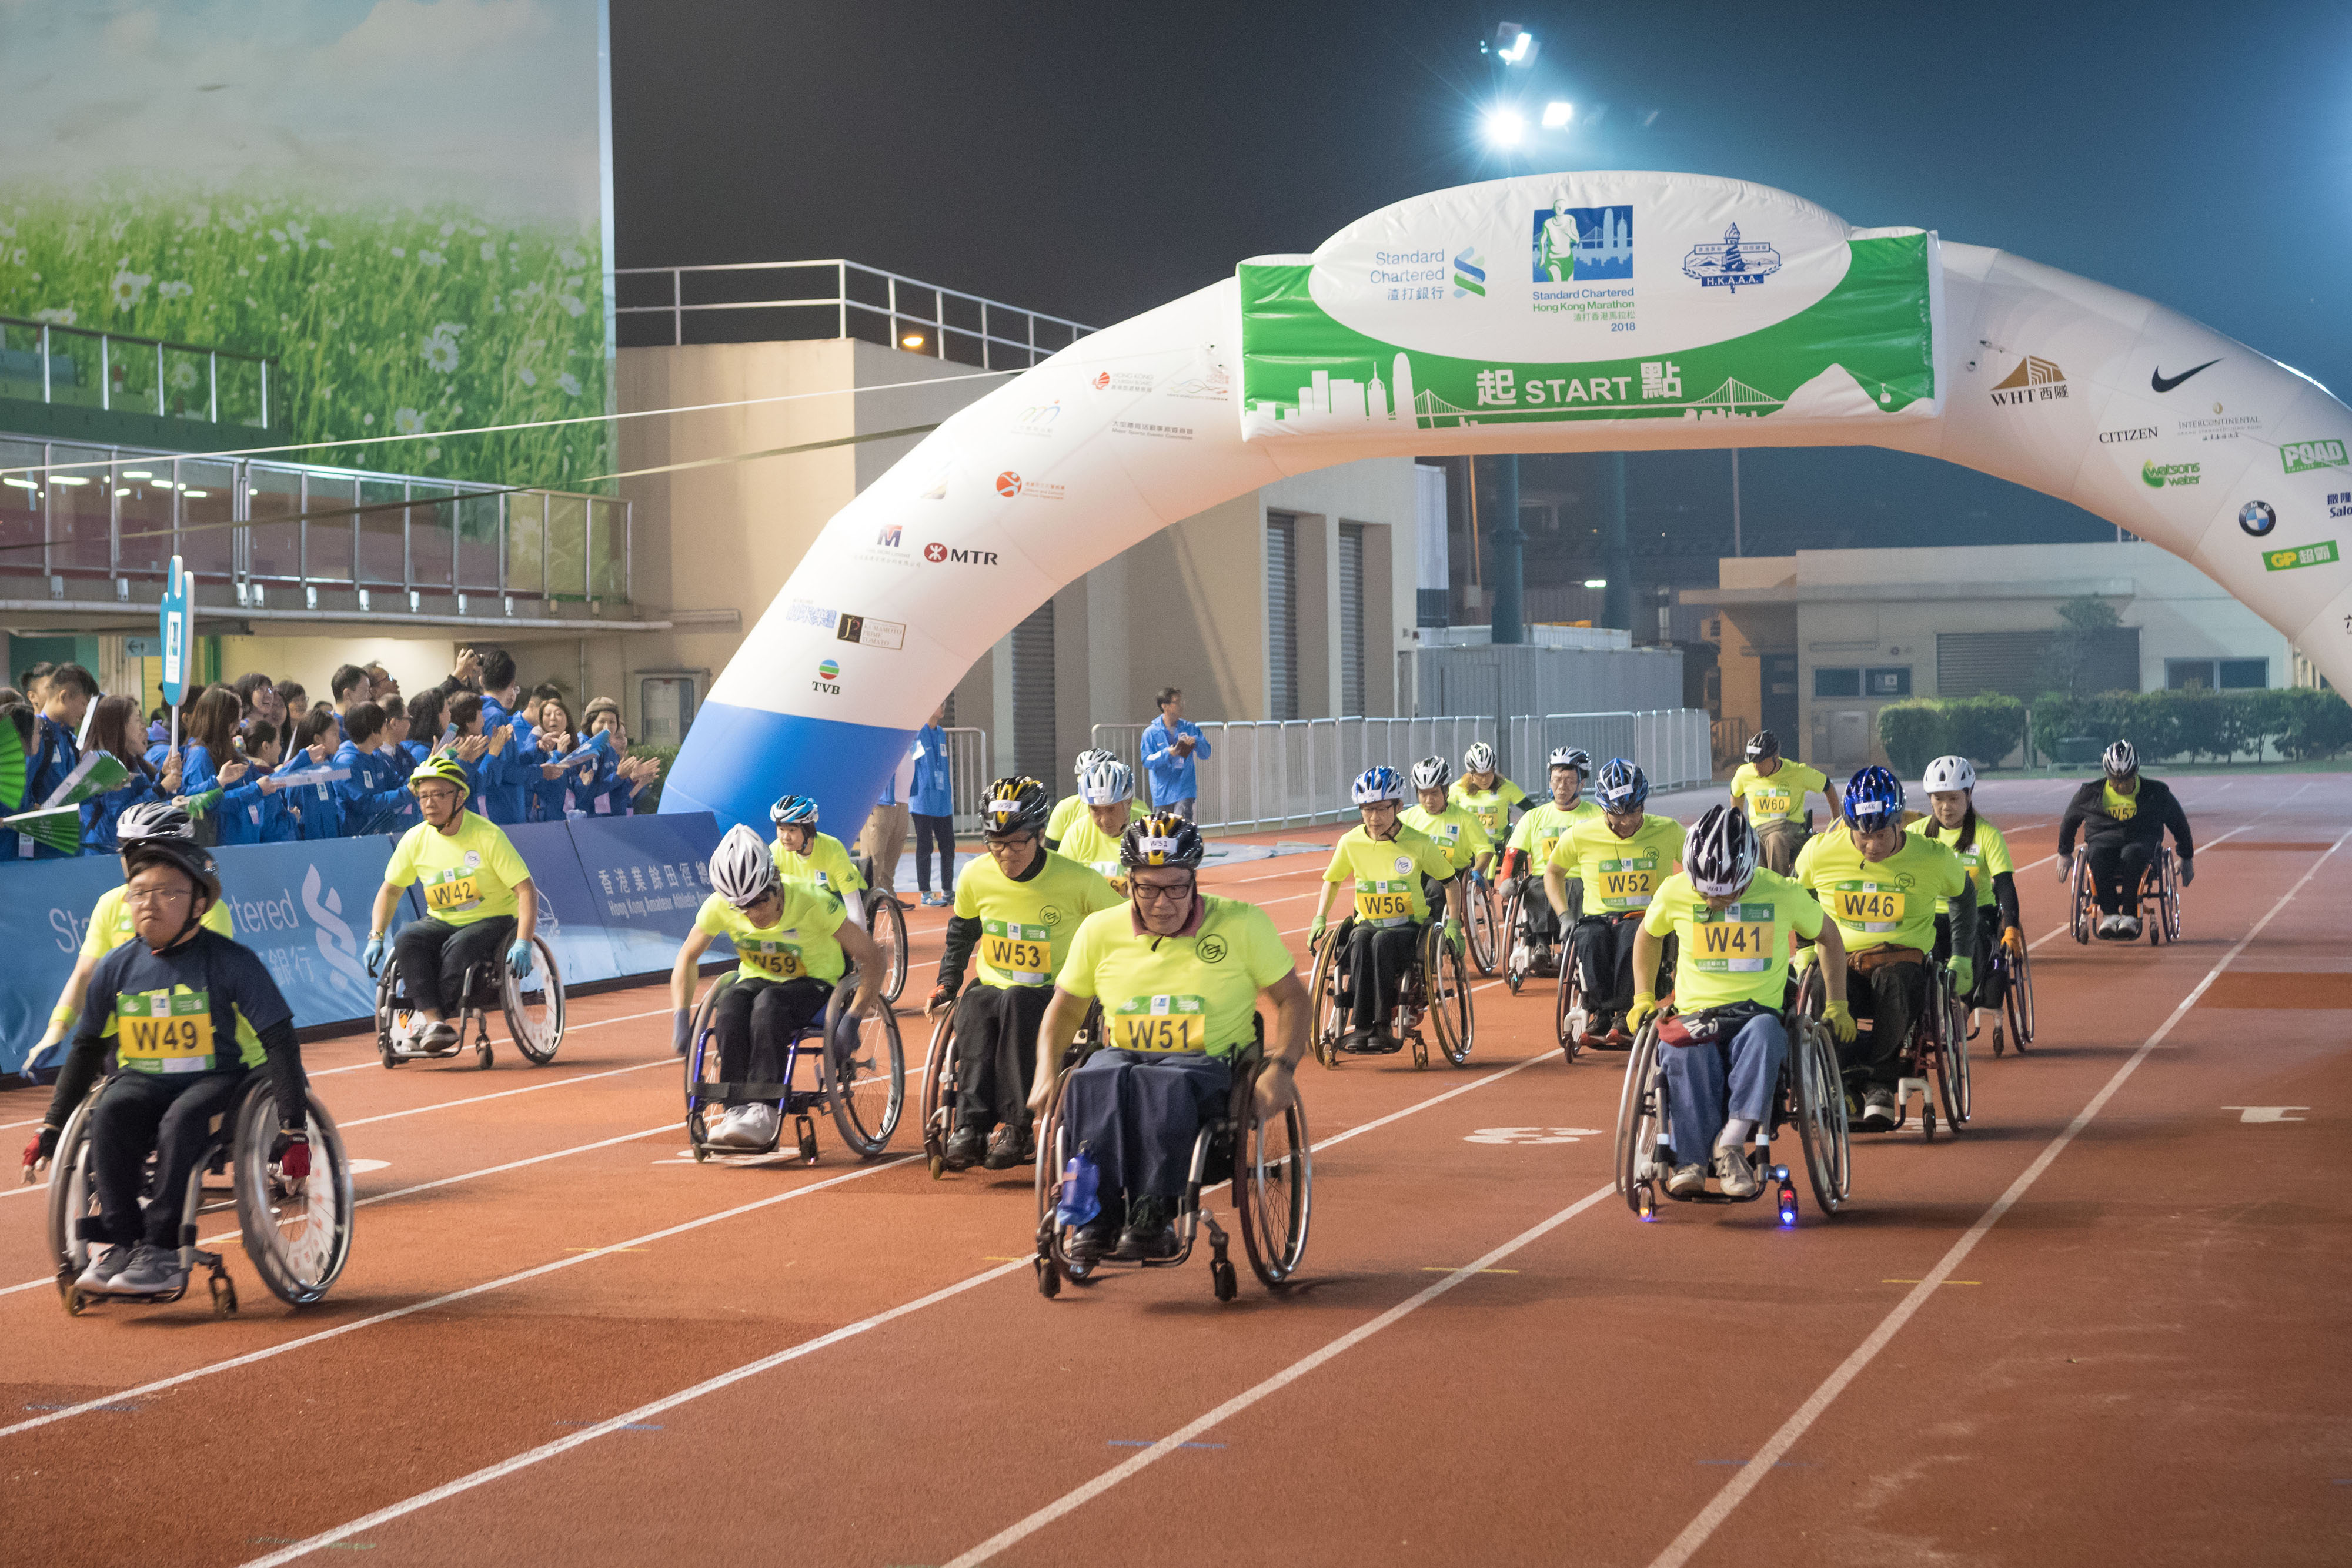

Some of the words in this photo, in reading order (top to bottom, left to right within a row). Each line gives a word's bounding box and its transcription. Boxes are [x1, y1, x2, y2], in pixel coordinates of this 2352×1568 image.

[1376, 248, 1444, 265] Standard
[1371, 266, 1444, 284] Chartered
[1706, 275, 1759, 286] H.K.A.A.A.
[1388, 286, 1444, 300] 渣打銀行
[1533, 290, 1579, 300] Standard
[1582, 287, 1634, 298] Chartered
[1533, 303, 1558, 313] Hong
[1560, 302, 1585, 312] Kong
[1587, 300, 1635, 310] Marathon
[1573, 310, 1635, 322] 渣打香港馬拉松
[1611, 322, 1636, 332] 2018
[1476, 369, 1516, 406] 起
[1525, 377, 1631, 403] START
[1641, 360, 1682, 399] 點
[1990, 389, 2036, 407] WHT
[2039, 384, 2069, 400] 西隧
[2099, 427, 2158, 444] CITIZEN
[2284, 442, 2343, 467] POAD
[2167, 474, 2201, 487] water
[951, 549, 998, 565] MTR
[2271, 551, 2297, 567] GP
[812, 681, 840, 695] TVB
[1759, 798, 1785, 810] W60
[598, 861, 711, 895] 香港業餘田徑總
[1608, 874, 1649, 893] W52
[433, 882, 473, 904] W42
[1364, 896, 1405, 914] W56
[1845, 894, 1894, 917] W46
[1705, 927, 1760, 952] W41
[992, 940, 1040, 968] W53
[132, 1021, 198, 1051] W49
[1128, 1019, 1188, 1049] W51
